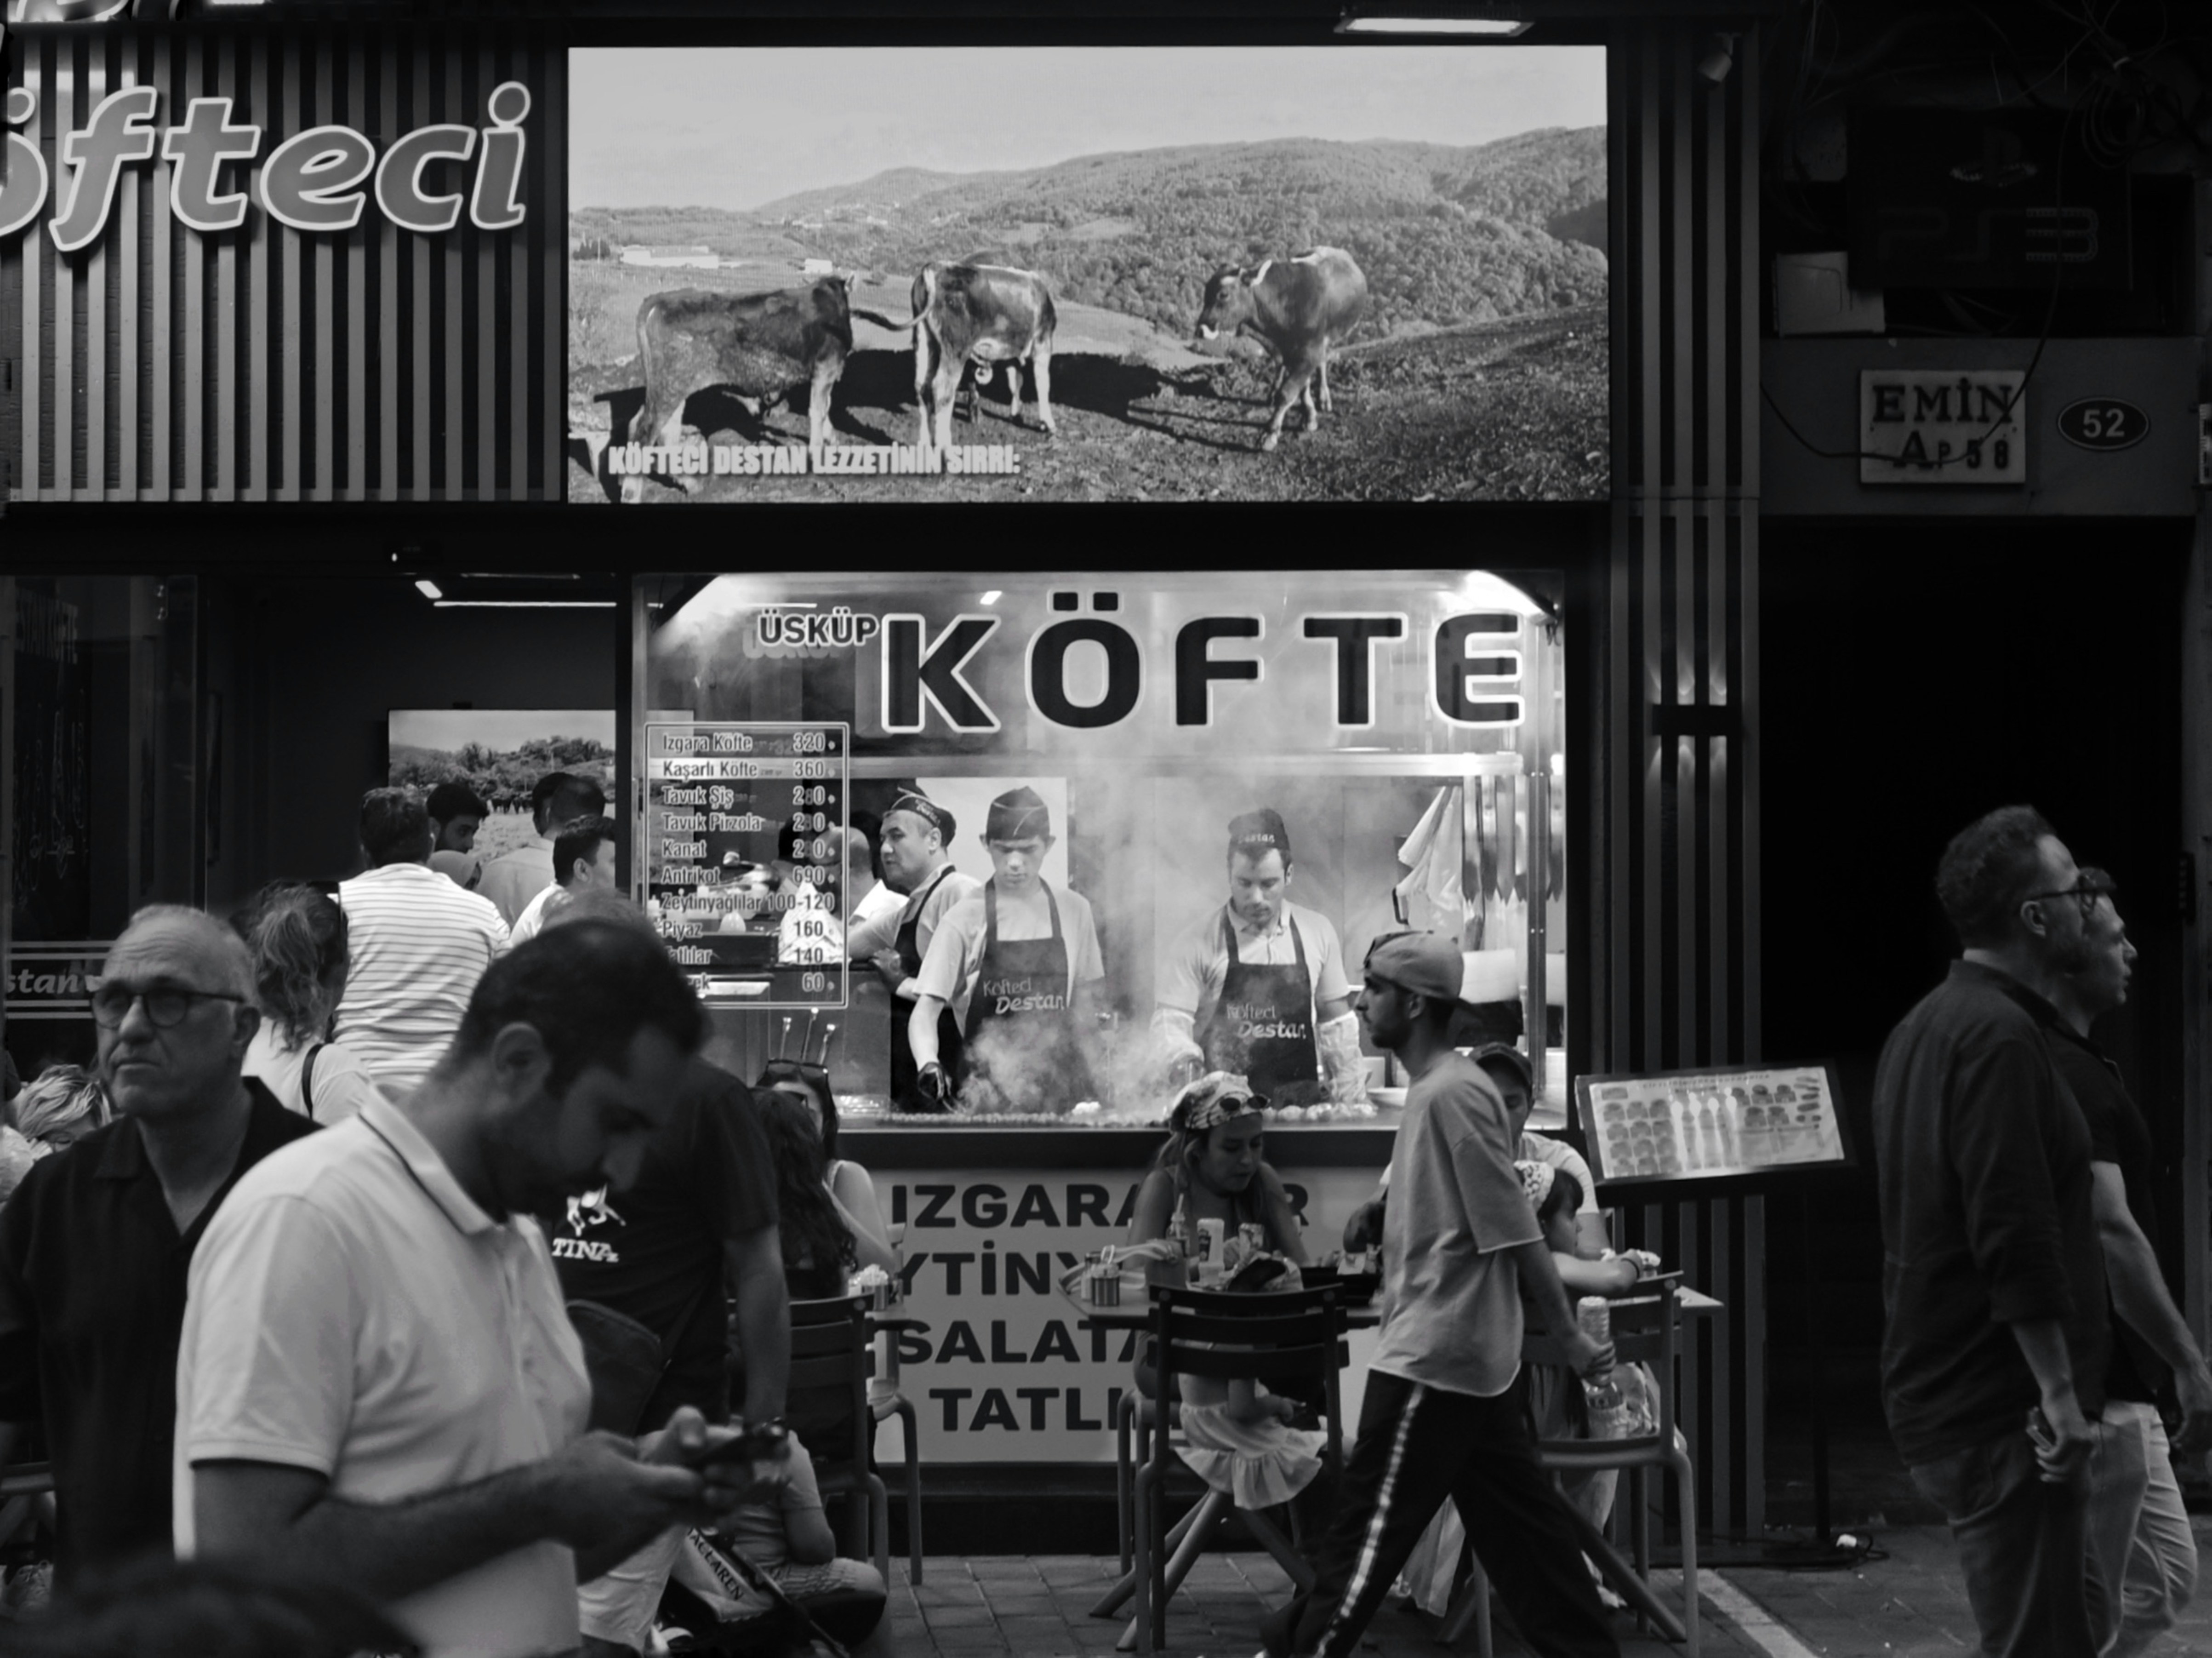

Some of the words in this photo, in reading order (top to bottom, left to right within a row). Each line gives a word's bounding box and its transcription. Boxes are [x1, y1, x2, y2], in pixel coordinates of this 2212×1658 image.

[1877, 207, 2099, 263] PS3
[1872, 377, 2013, 423] EMİN
[2082, 409, 2125, 438] 52
[608, 440, 708, 475] KÖFTECİ
[713, 446, 807, 475] DESTAN
[812, 440, 941, 474] LEZZETİNİN
[947, 445, 1020, 474] SIRRI:
[1965, 439, 2009, 469] 58
[758, 606, 878, 646] ÜSKÜP
[880, 588, 1526, 733] KÖFTE
[662, 733, 709, 753] Izgara
[713, 732, 753, 751] Köfte
[793, 732, 825, 751] 320
[662, 760, 714, 782] Kaşarlı
[720, 760, 758, 777] Köfte
[793, 760, 825, 777] 360
[661, 785, 707, 805] Tavuk
[709, 785, 734, 809] Şiş
[792, 785, 825, 806] 280
[661, 812, 707, 831] Tavuk
[709, 812, 762, 831] Pirzola
[662, 838, 707, 858] Kanat
[661, 865, 721, 885] Antrikot
[792, 865, 825, 885] 690
[767, 892, 835, 911] 100-120
[661, 920, 702, 941] Piyaz
[795, 920, 823, 937] 160
[667, 945, 713, 964] atlılar
[795, 947, 823, 963] 140
[7, 969, 79, 995] stan
[802, 972, 825, 992] 60
[995, 992, 1065, 1015] Destan
[891, 1183, 1309, 1228] IZGARR
[899, 1319, 1138, 1364] SALAT
[929, 1386, 1136, 1432] TATLI
